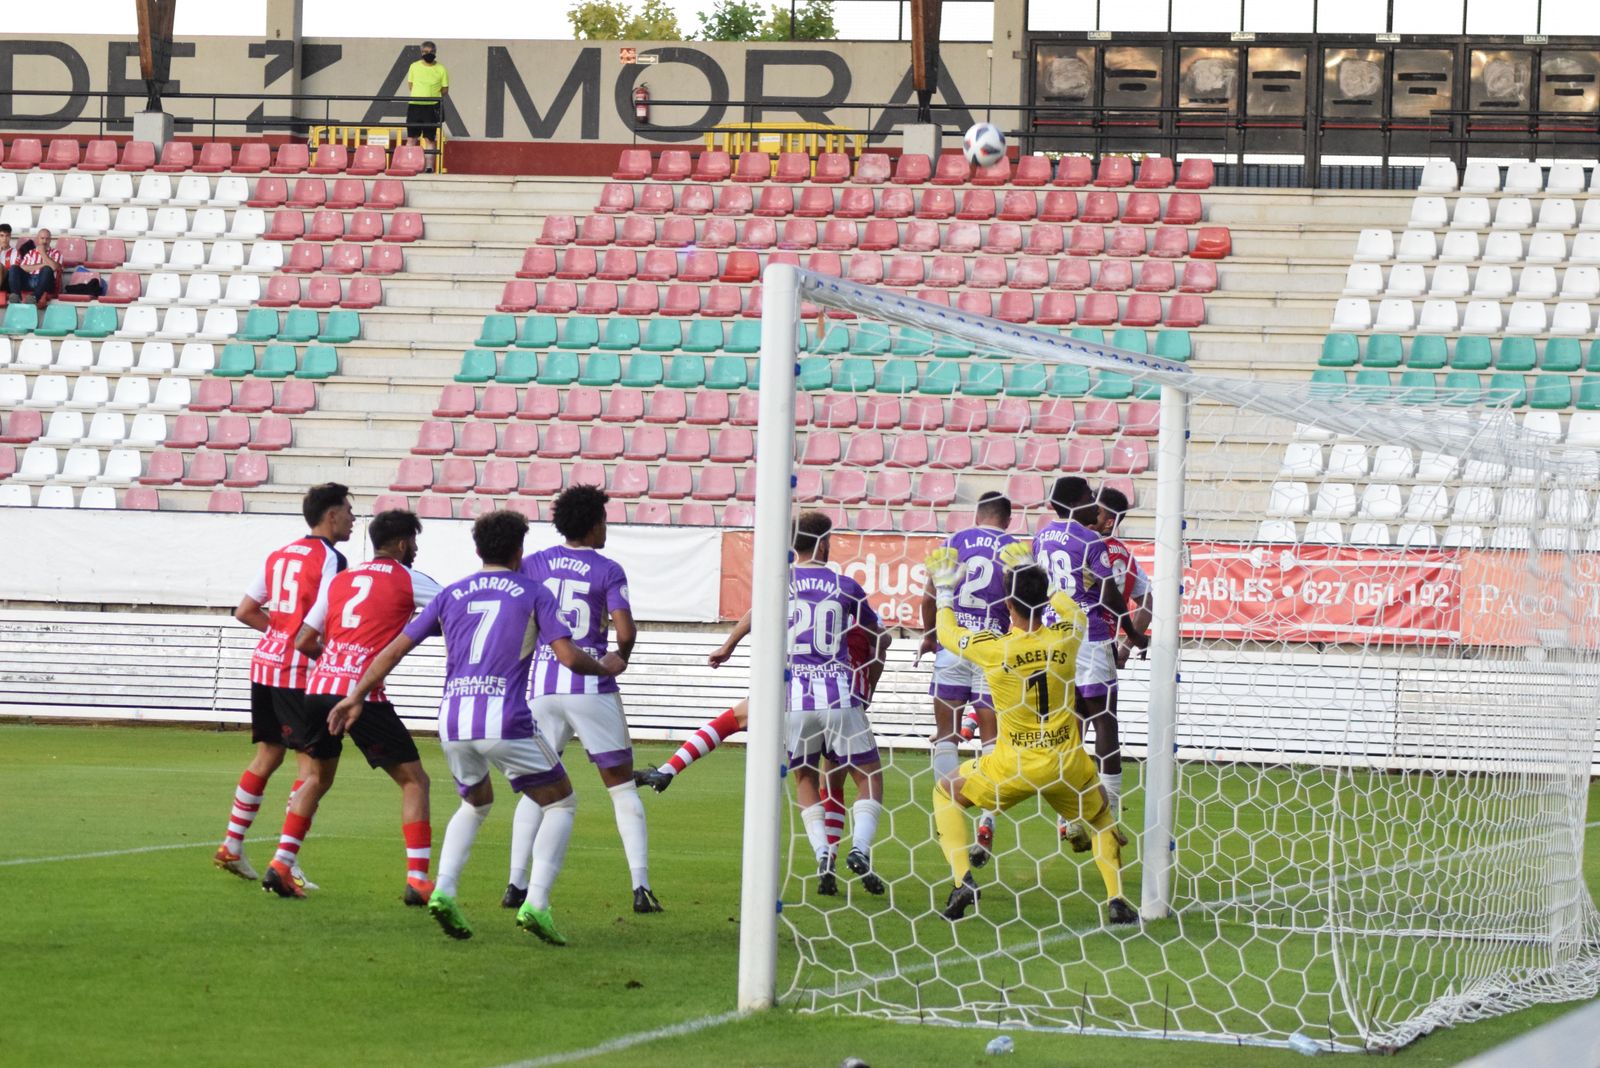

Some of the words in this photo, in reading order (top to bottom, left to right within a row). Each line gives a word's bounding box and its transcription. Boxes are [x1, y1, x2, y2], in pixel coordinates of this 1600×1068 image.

[0, 39, 196, 132] DE
[246, 40, 979, 143] ZAMORA
[964, 536, 1004, 553] L.ROS
[1040, 529, 1070, 546] CEDRIC
[548, 557, 591, 576] VICTOR
[269, 558, 303, 614] 15
[451, 576, 525, 601] R.ARROYO
[788, 577, 841, 598] UINTAN
[958, 555, 994, 609] 2
[1182, 576, 1273, 603] CABLES
[1302, 581, 1347, 605] 627
[1353, 582, 1395, 607] 051
[1406, 583, 1450, 608] 192
[341, 575, 373, 628] 2
[878, 598, 914, 621] de
[1179, 603, 1206, 617] ora)
[467, 600, 501, 665] 7
[788, 600, 843, 656] 20
[1025, 670, 1049, 724] 1
[1009, 725, 1070, 741] HERBALIFE
